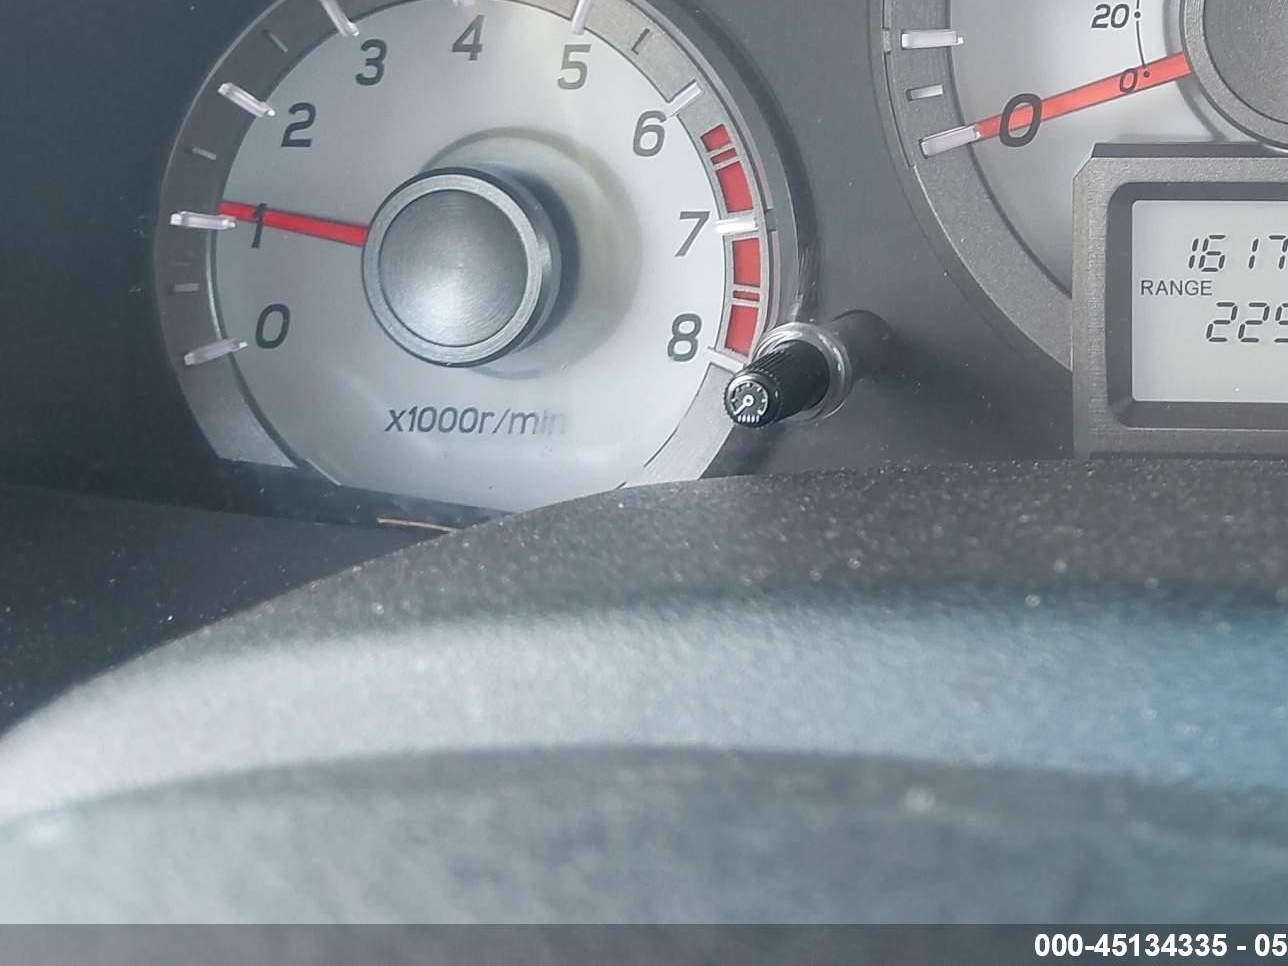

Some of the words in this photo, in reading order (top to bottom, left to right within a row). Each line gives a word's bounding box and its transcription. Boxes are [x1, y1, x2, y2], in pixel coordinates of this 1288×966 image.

[451, 15, 484, 62] 4
[1090, 4, 1130, 29] 20
[355, 38, 388, 87] 3
[557, 44, 592, 91] 5
[1119, 68, 1138, 93] 0
[281, 102, 317, 149] 2
[632, 110, 667, 158] 6
[1000, 93, 1042, 148] 0
[674, 211, 711, 257] 7
[1140, 280, 1213, 296] RANGE
[254, 303, 290, 350] 0
[667, 313, 703, 361] 8
[384, 406, 565, 436] x1000r/min
